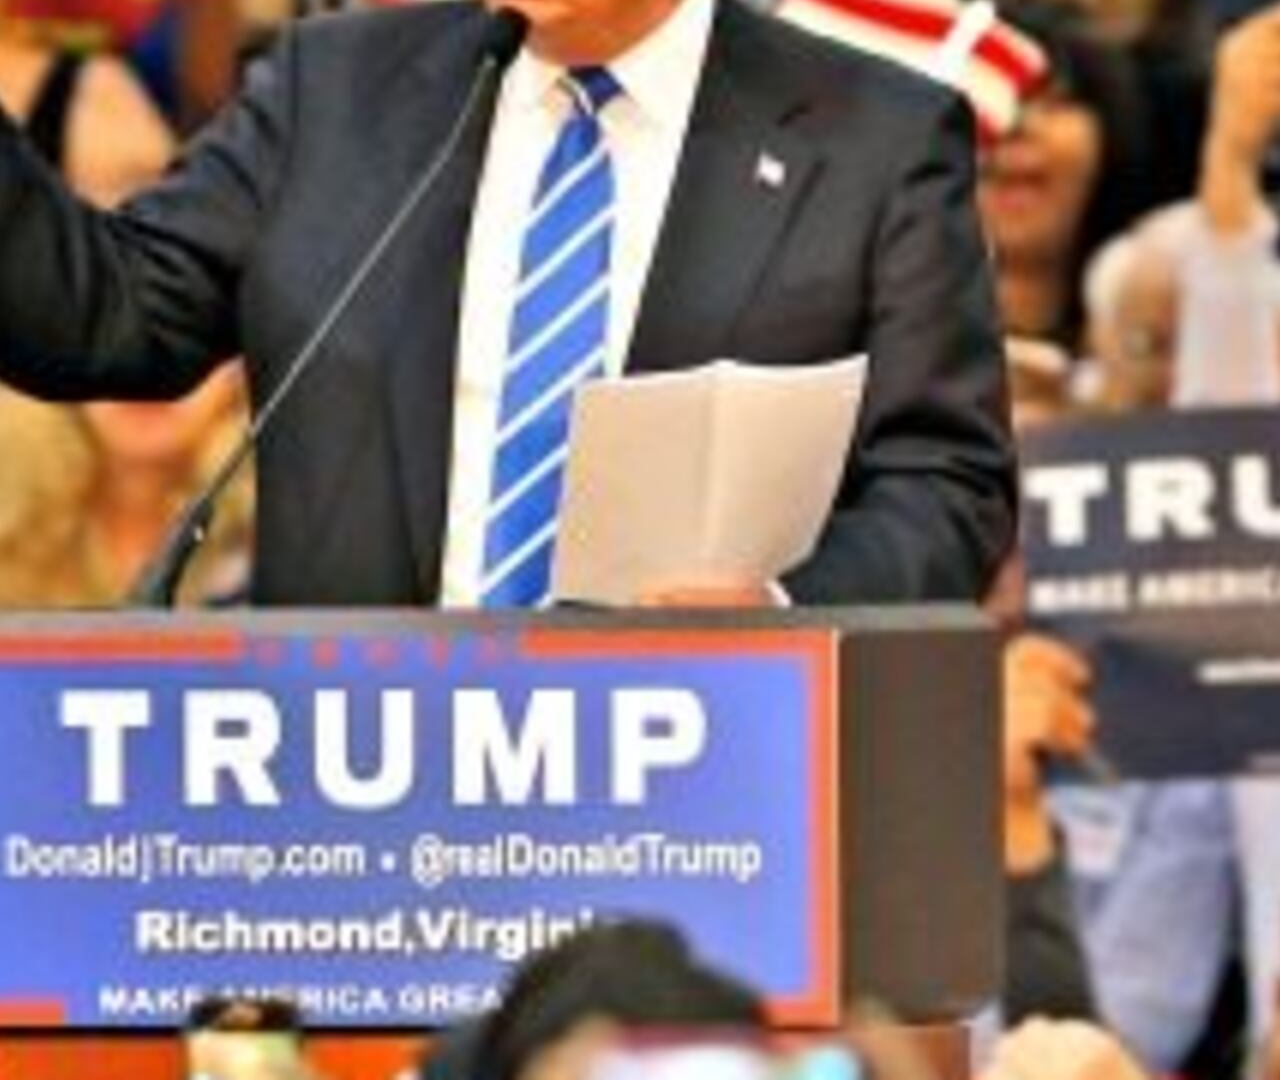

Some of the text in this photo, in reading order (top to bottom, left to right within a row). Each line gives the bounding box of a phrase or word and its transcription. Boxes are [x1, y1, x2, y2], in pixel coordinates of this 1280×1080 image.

[60, 688, 708, 810] TRUMP
[410, 832, 763, 888] @realDonaldTrump
[396, 982, 502, 1016] GREA
